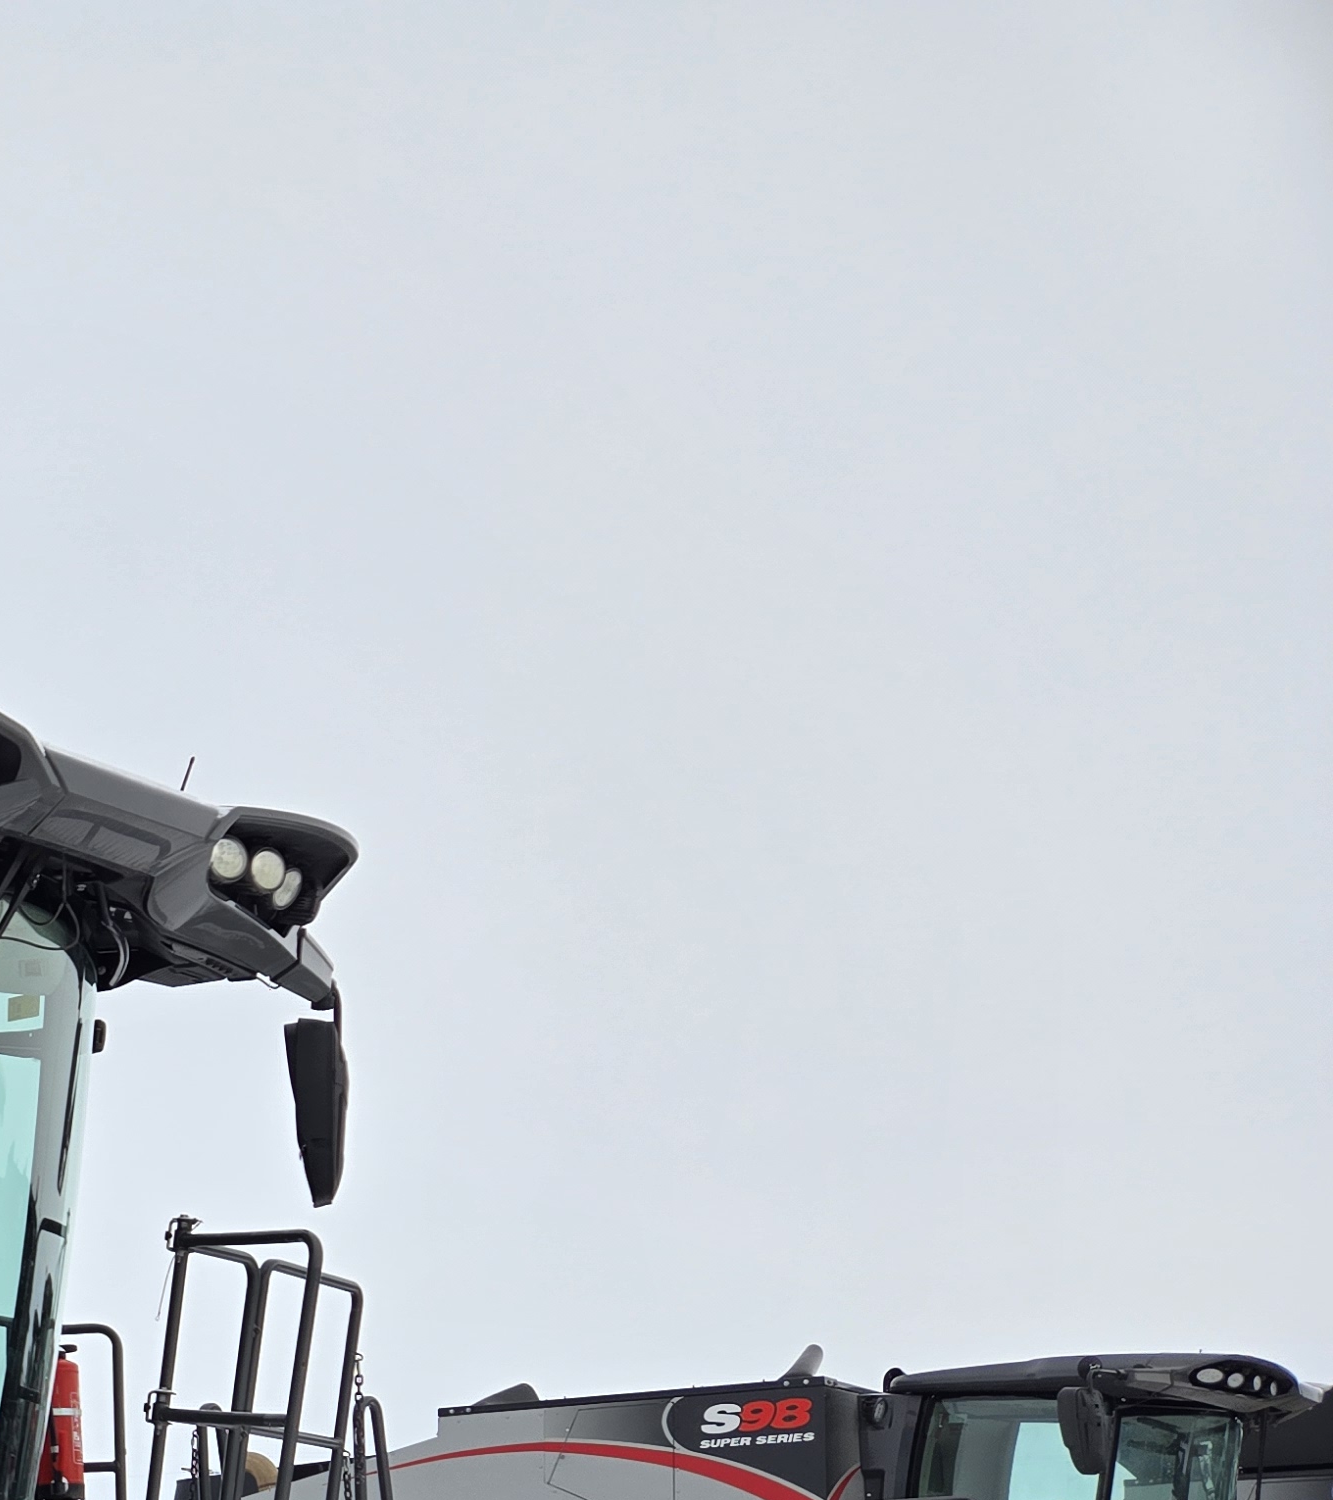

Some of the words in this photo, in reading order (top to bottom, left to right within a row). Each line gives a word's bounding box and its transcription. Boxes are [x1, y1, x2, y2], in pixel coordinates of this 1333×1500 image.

[700, 1397, 813, 1434] S98
[699, 1436, 752, 1449] SUPER
[755, 1432, 815, 1445] SERIES
